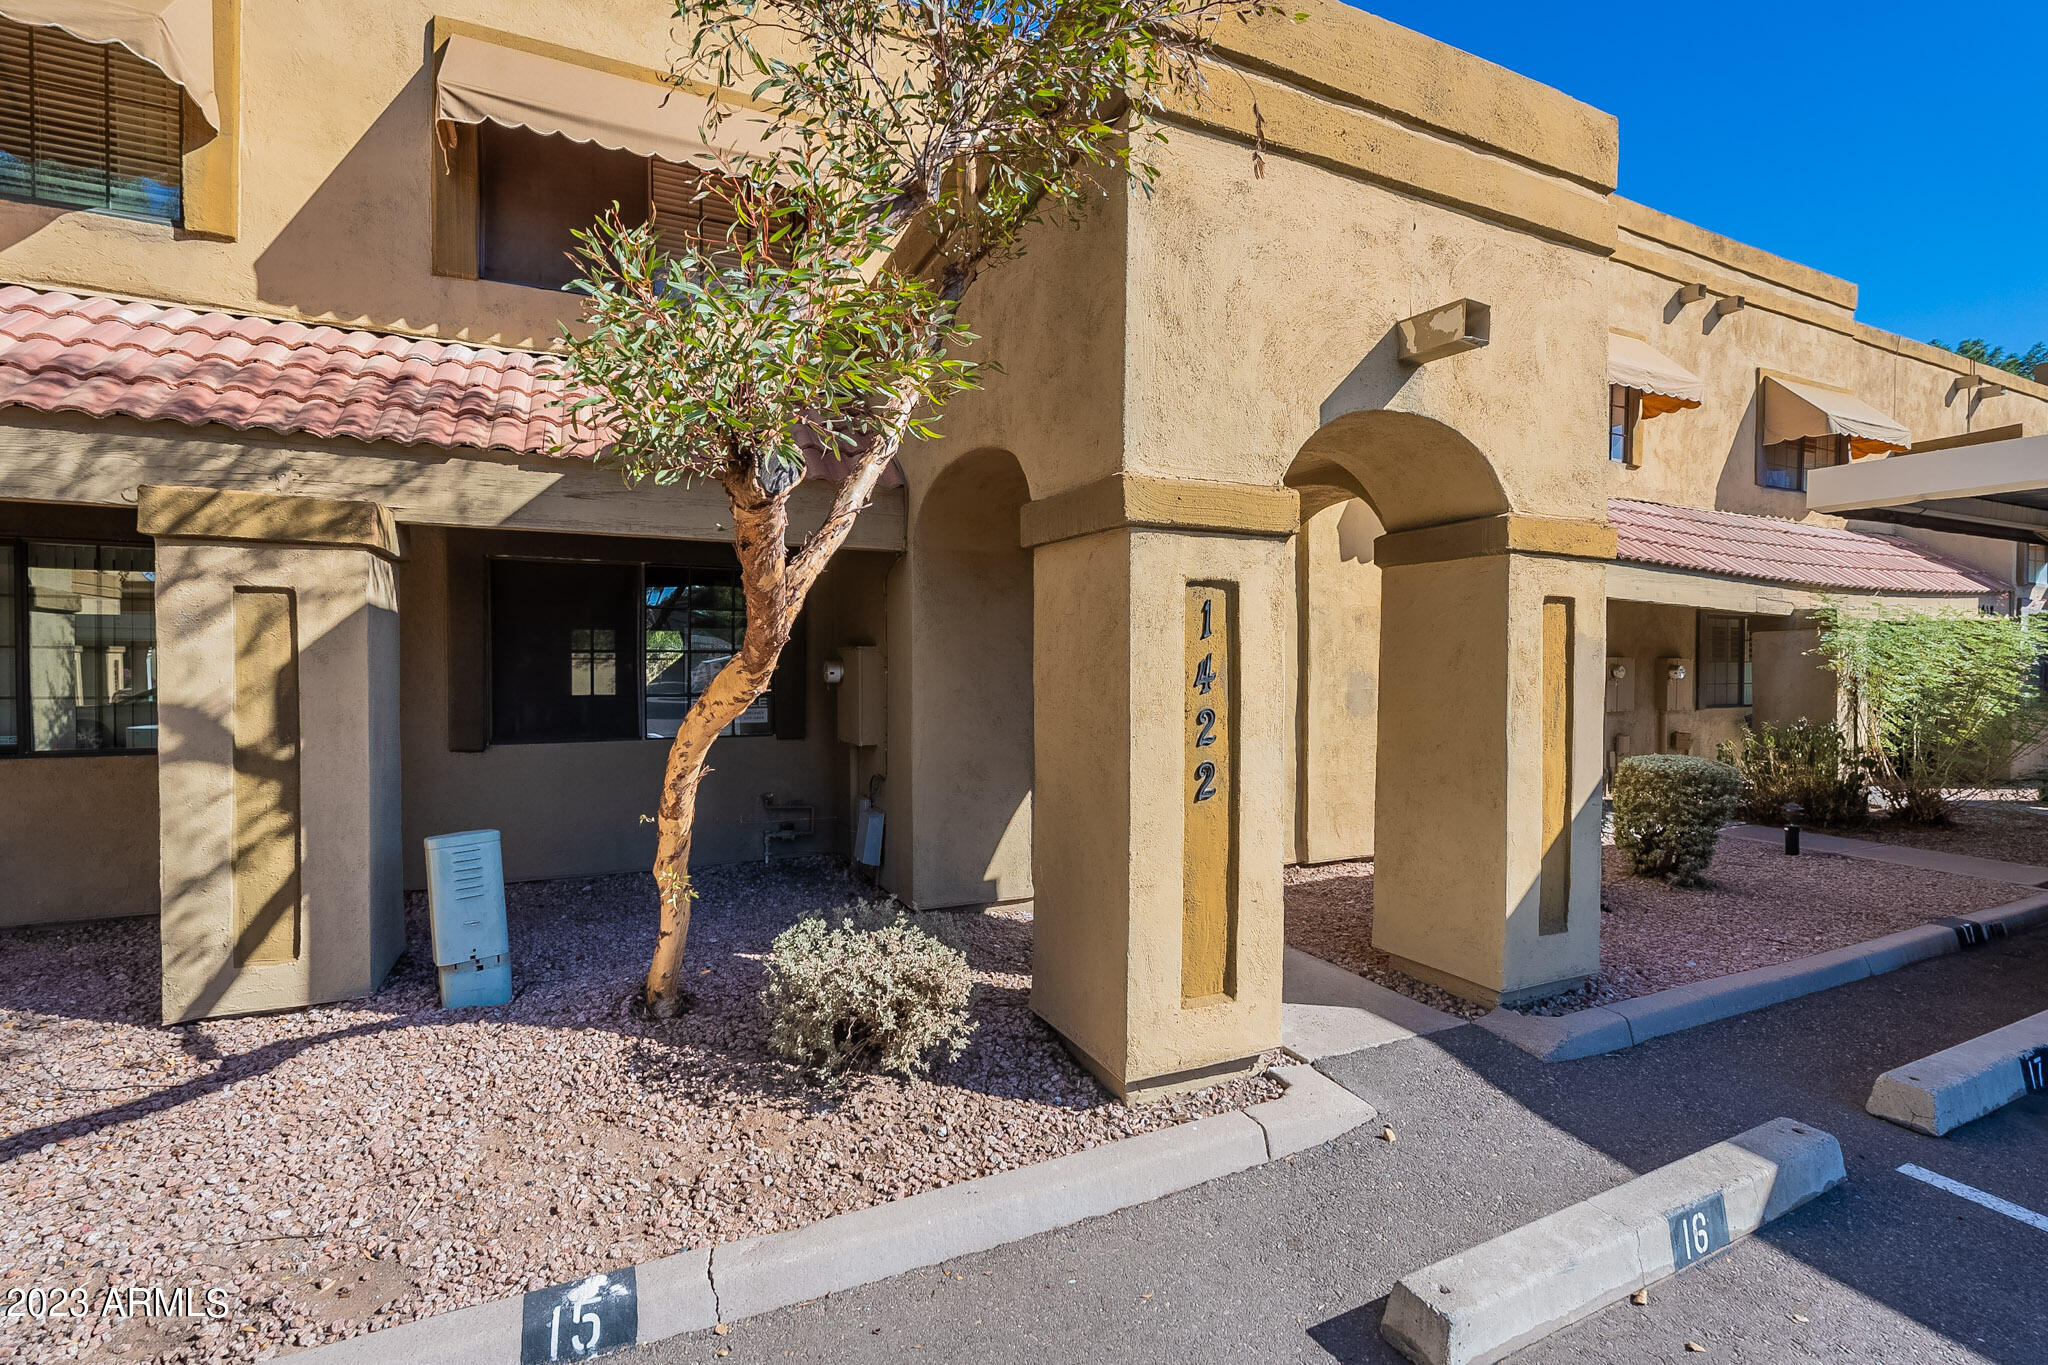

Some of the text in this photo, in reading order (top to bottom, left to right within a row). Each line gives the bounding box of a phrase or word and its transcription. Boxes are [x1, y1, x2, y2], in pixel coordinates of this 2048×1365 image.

[1194, 599, 1217, 802] 1422
[1683, 1211, 1709, 1260] 16
[547, 1294, 602, 1361] 15
